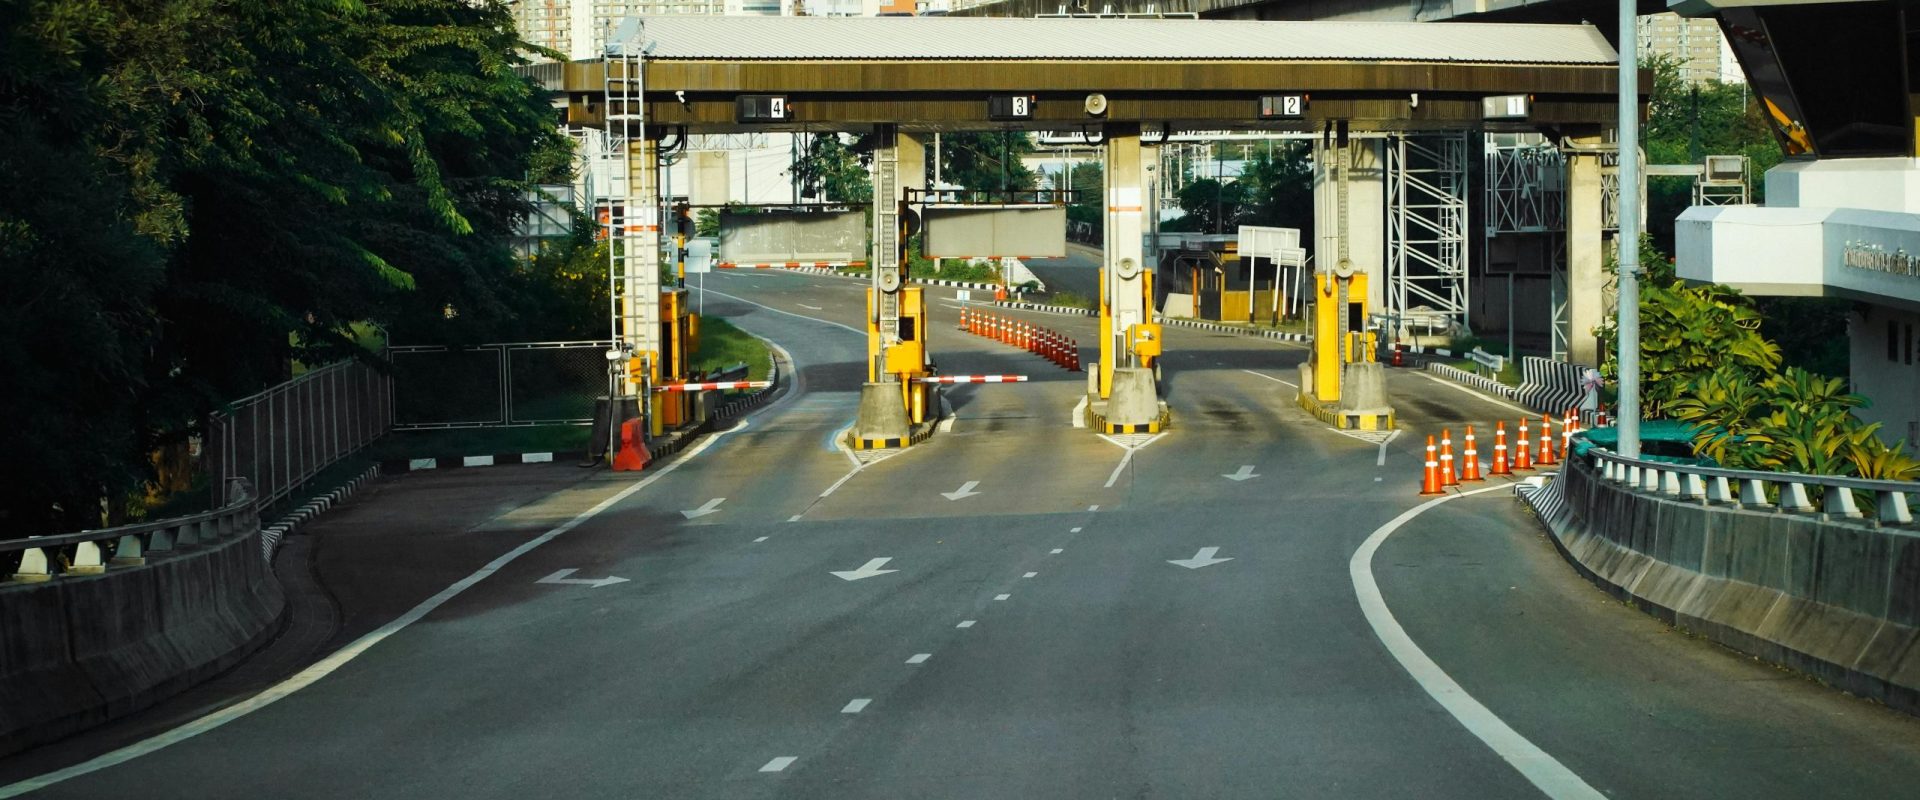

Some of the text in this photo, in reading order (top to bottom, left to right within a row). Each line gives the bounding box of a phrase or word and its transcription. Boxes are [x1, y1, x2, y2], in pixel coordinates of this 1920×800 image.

[773, 100, 781, 115] 4
[1016, 98, 1024, 114] 3
[1288, 97, 1296, 113] 2
[1513, 98, 1518, 113] 1
